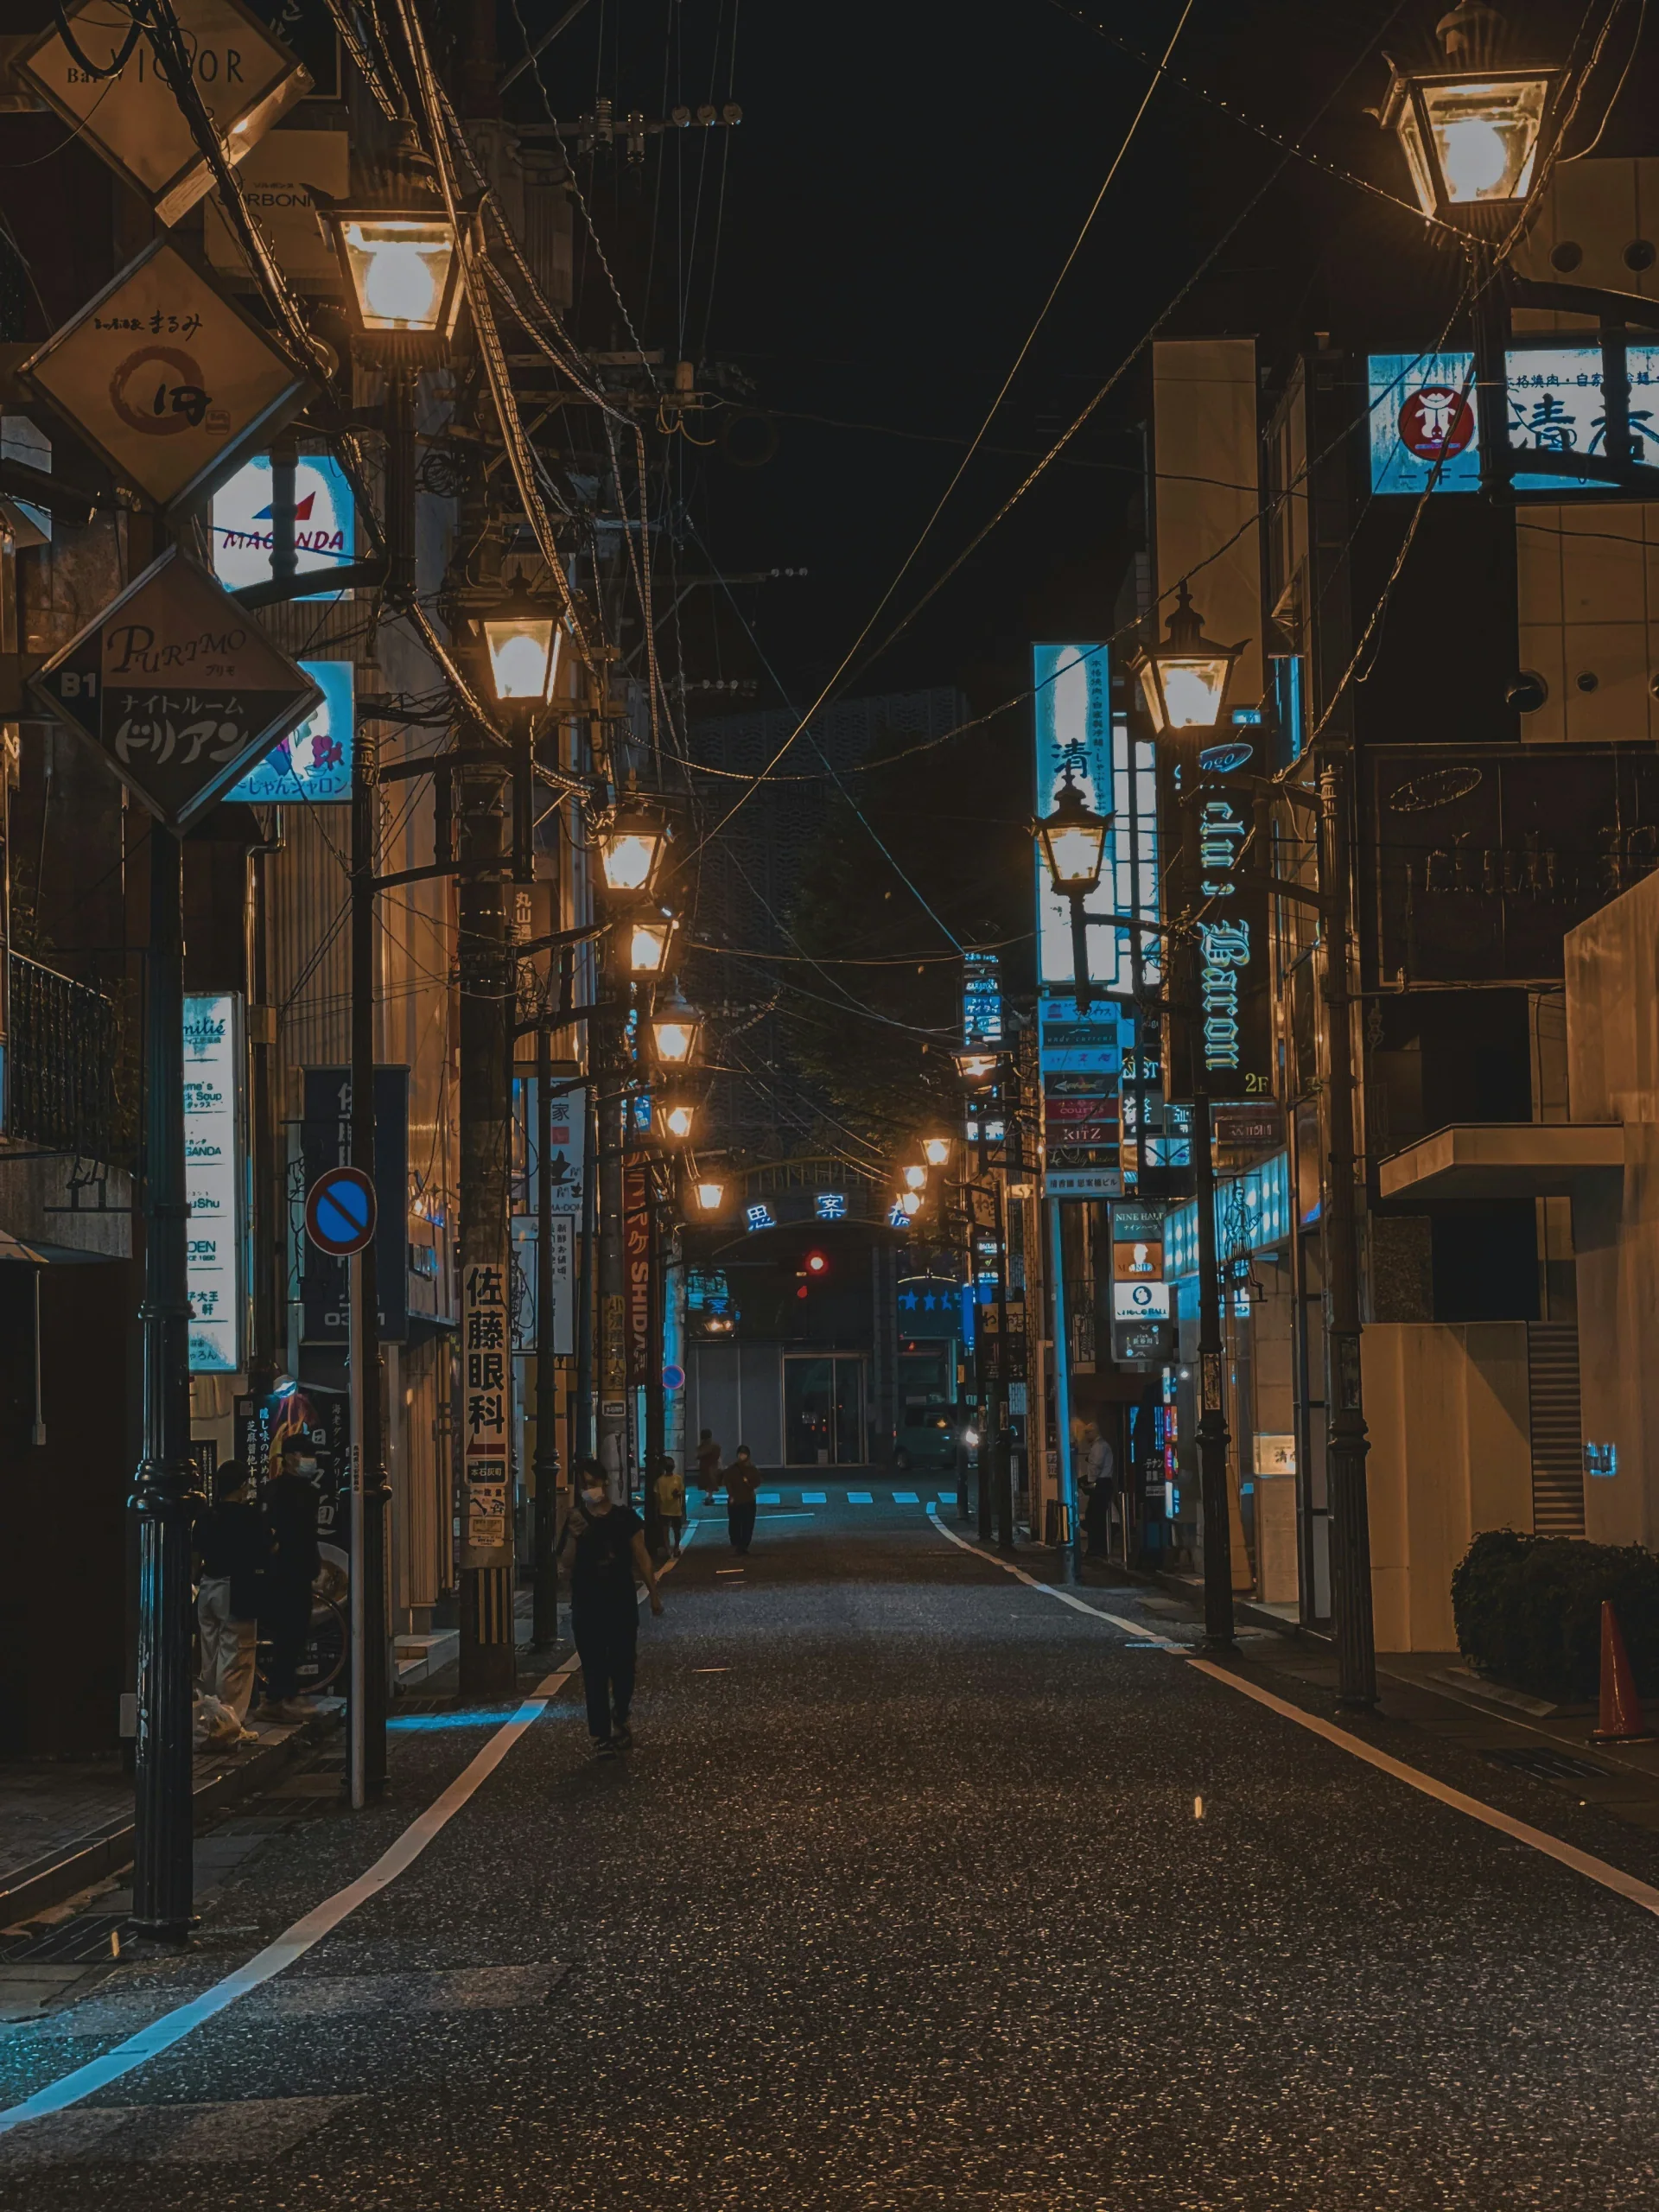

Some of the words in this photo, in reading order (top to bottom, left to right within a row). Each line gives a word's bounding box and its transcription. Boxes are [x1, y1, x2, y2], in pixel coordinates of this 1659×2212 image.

[149, 308, 203, 341] まるみ
[223, 530, 344, 550] MANDA
[60, 671, 97, 697] B1
[120, 694, 245, 715] ナイトルーム
[115, 718, 250, 765] ドリアン
[1197, 918, 1250, 1071] Baron
[1245, 1073, 1269, 1092] 2F
[185, 1146, 222, 1157] GANDA
[1116, 1212, 1139, 1221] NINE
[187, 1240, 216, 1253] DEN
[188, 1291, 219, 1302] 子大王
[466, 1266, 505, 1434] 佐藤眼科
